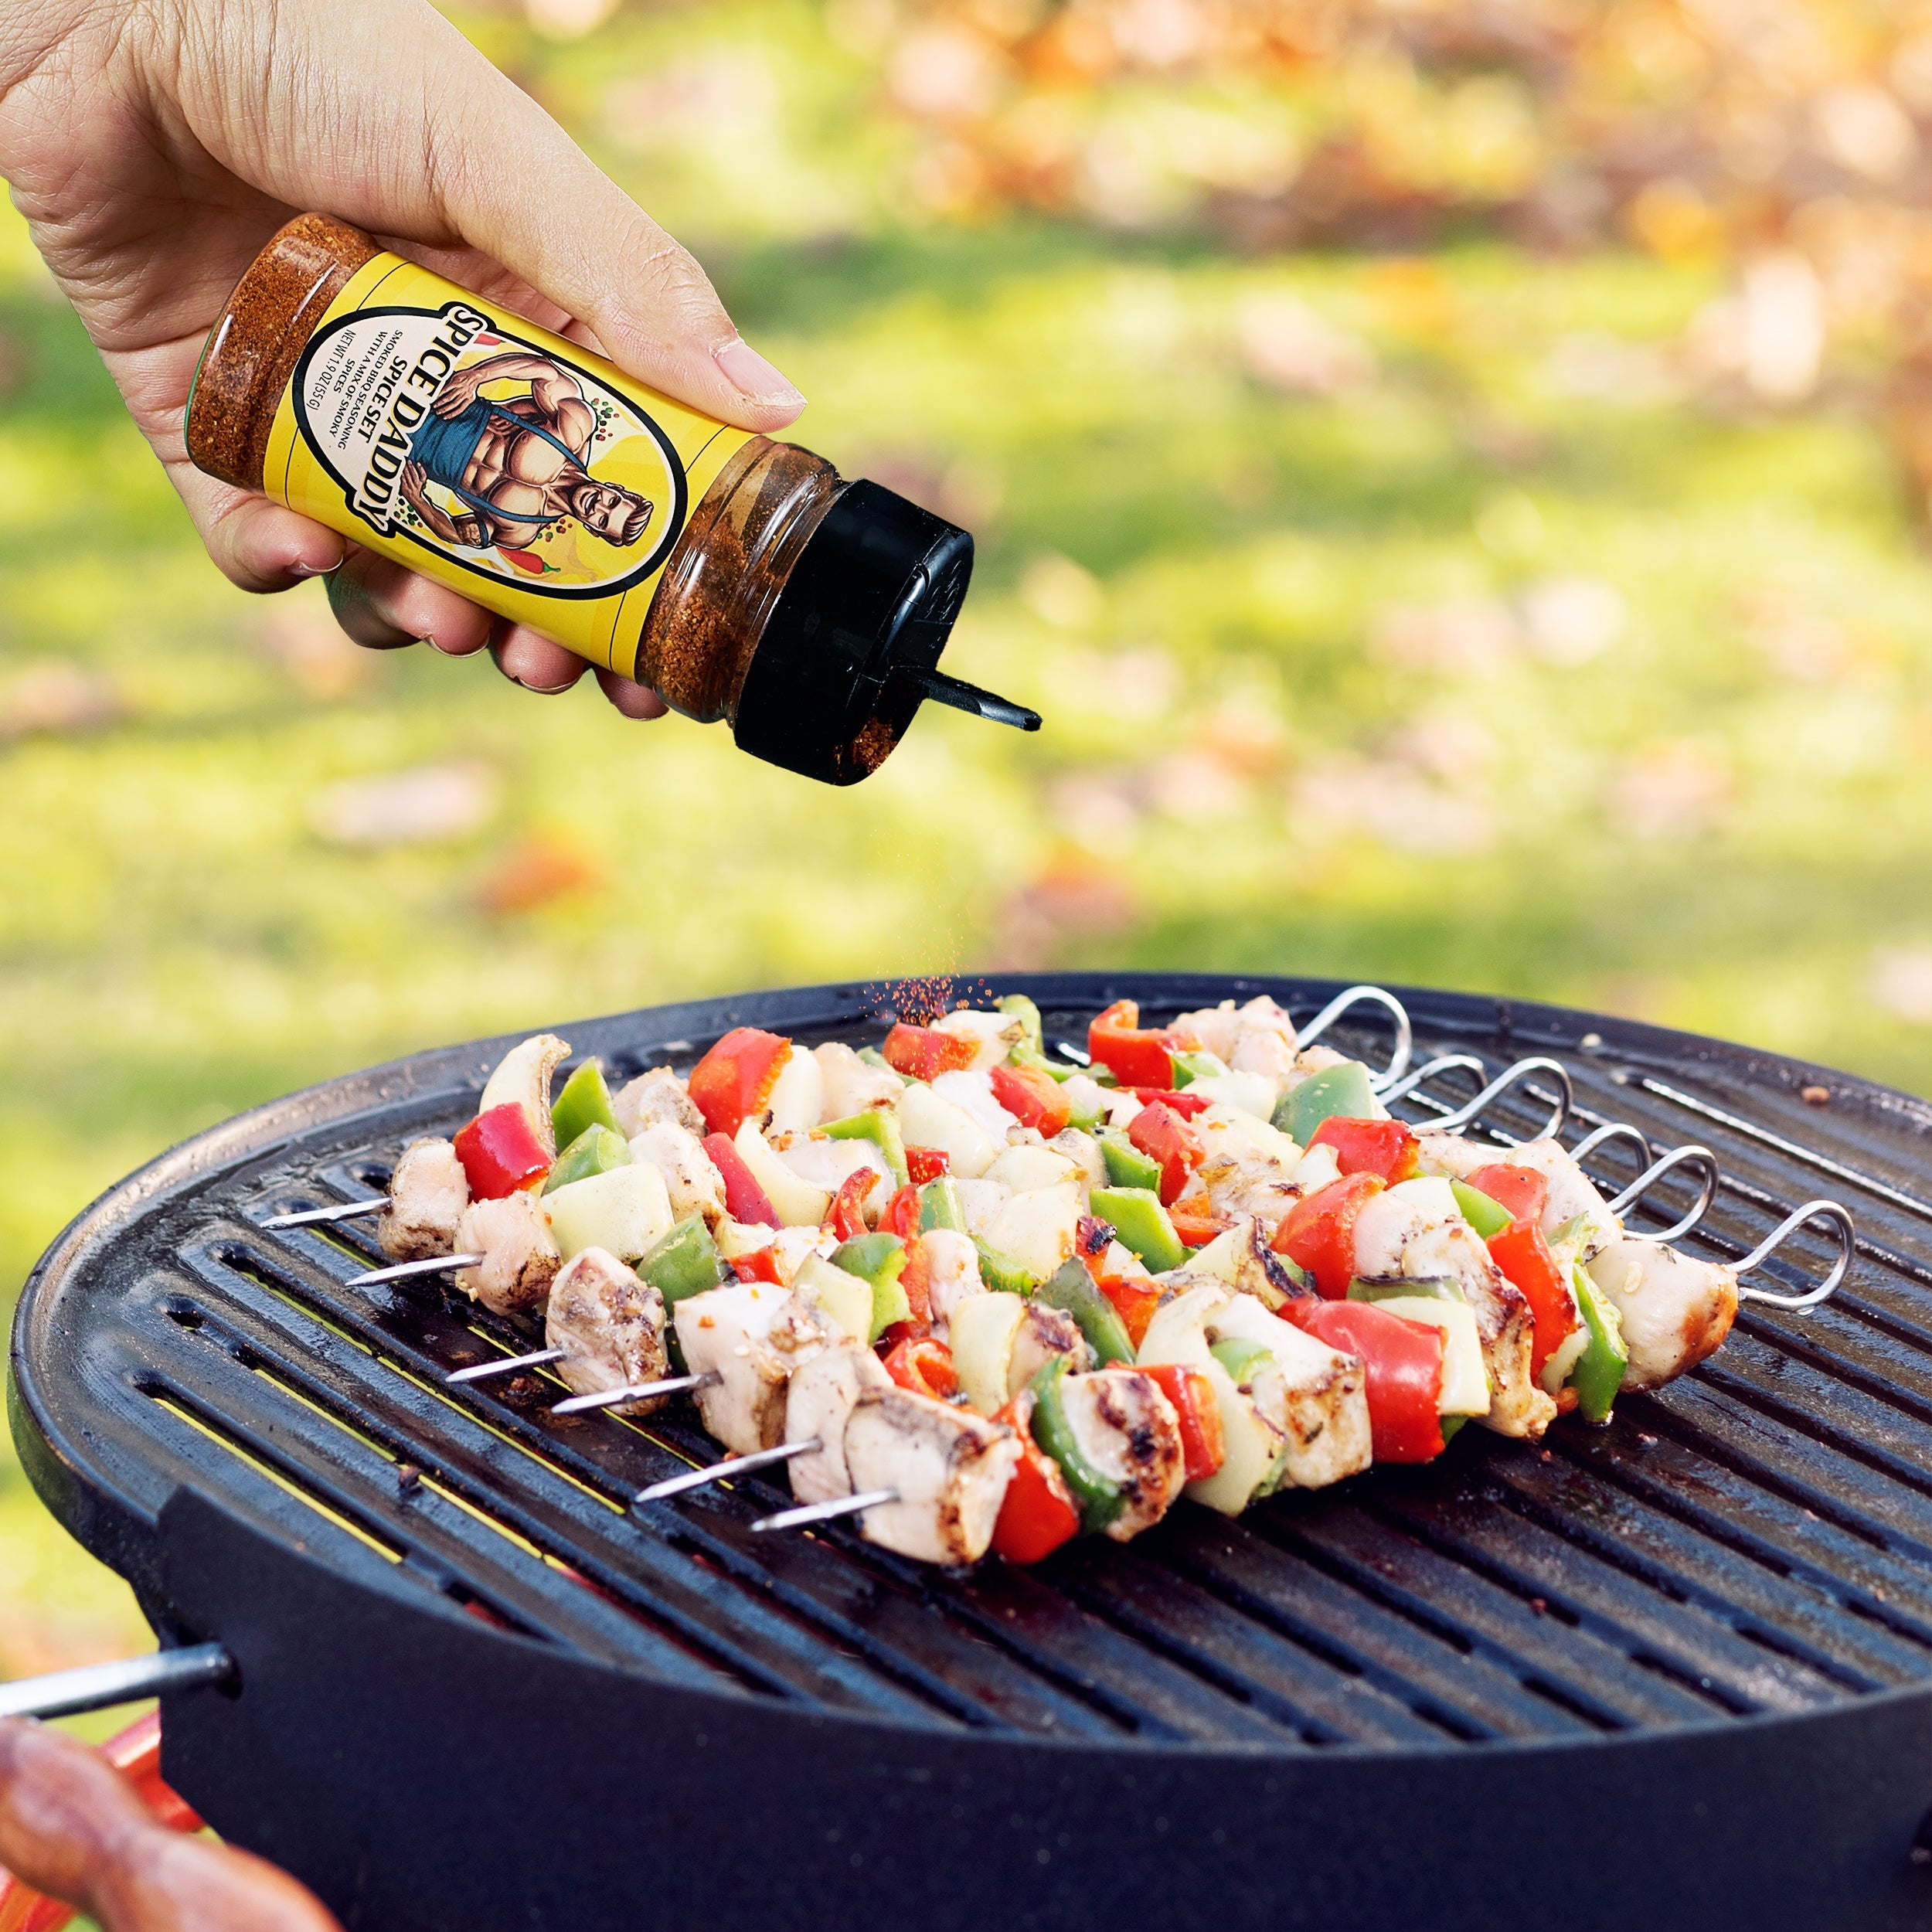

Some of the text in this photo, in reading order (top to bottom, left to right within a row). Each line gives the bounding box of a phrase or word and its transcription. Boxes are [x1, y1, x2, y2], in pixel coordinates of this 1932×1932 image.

[367, 332, 388, 356] WITH
[304, 329, 356, 410] NET WT 1.9 OZ (55 G)
[333, 359, 355, 393] SPICES
[351, 363, 367, 385] MIX
[338, 329, 403, 451] SMOKED BBQ SEASONING
[345, 385, 356, 400] OF
[357, 355, 408, 444] SPICE SET
[329, 399, 349, 437] SMOKY
[358, 310, 485, 528] SPICE DADDY
